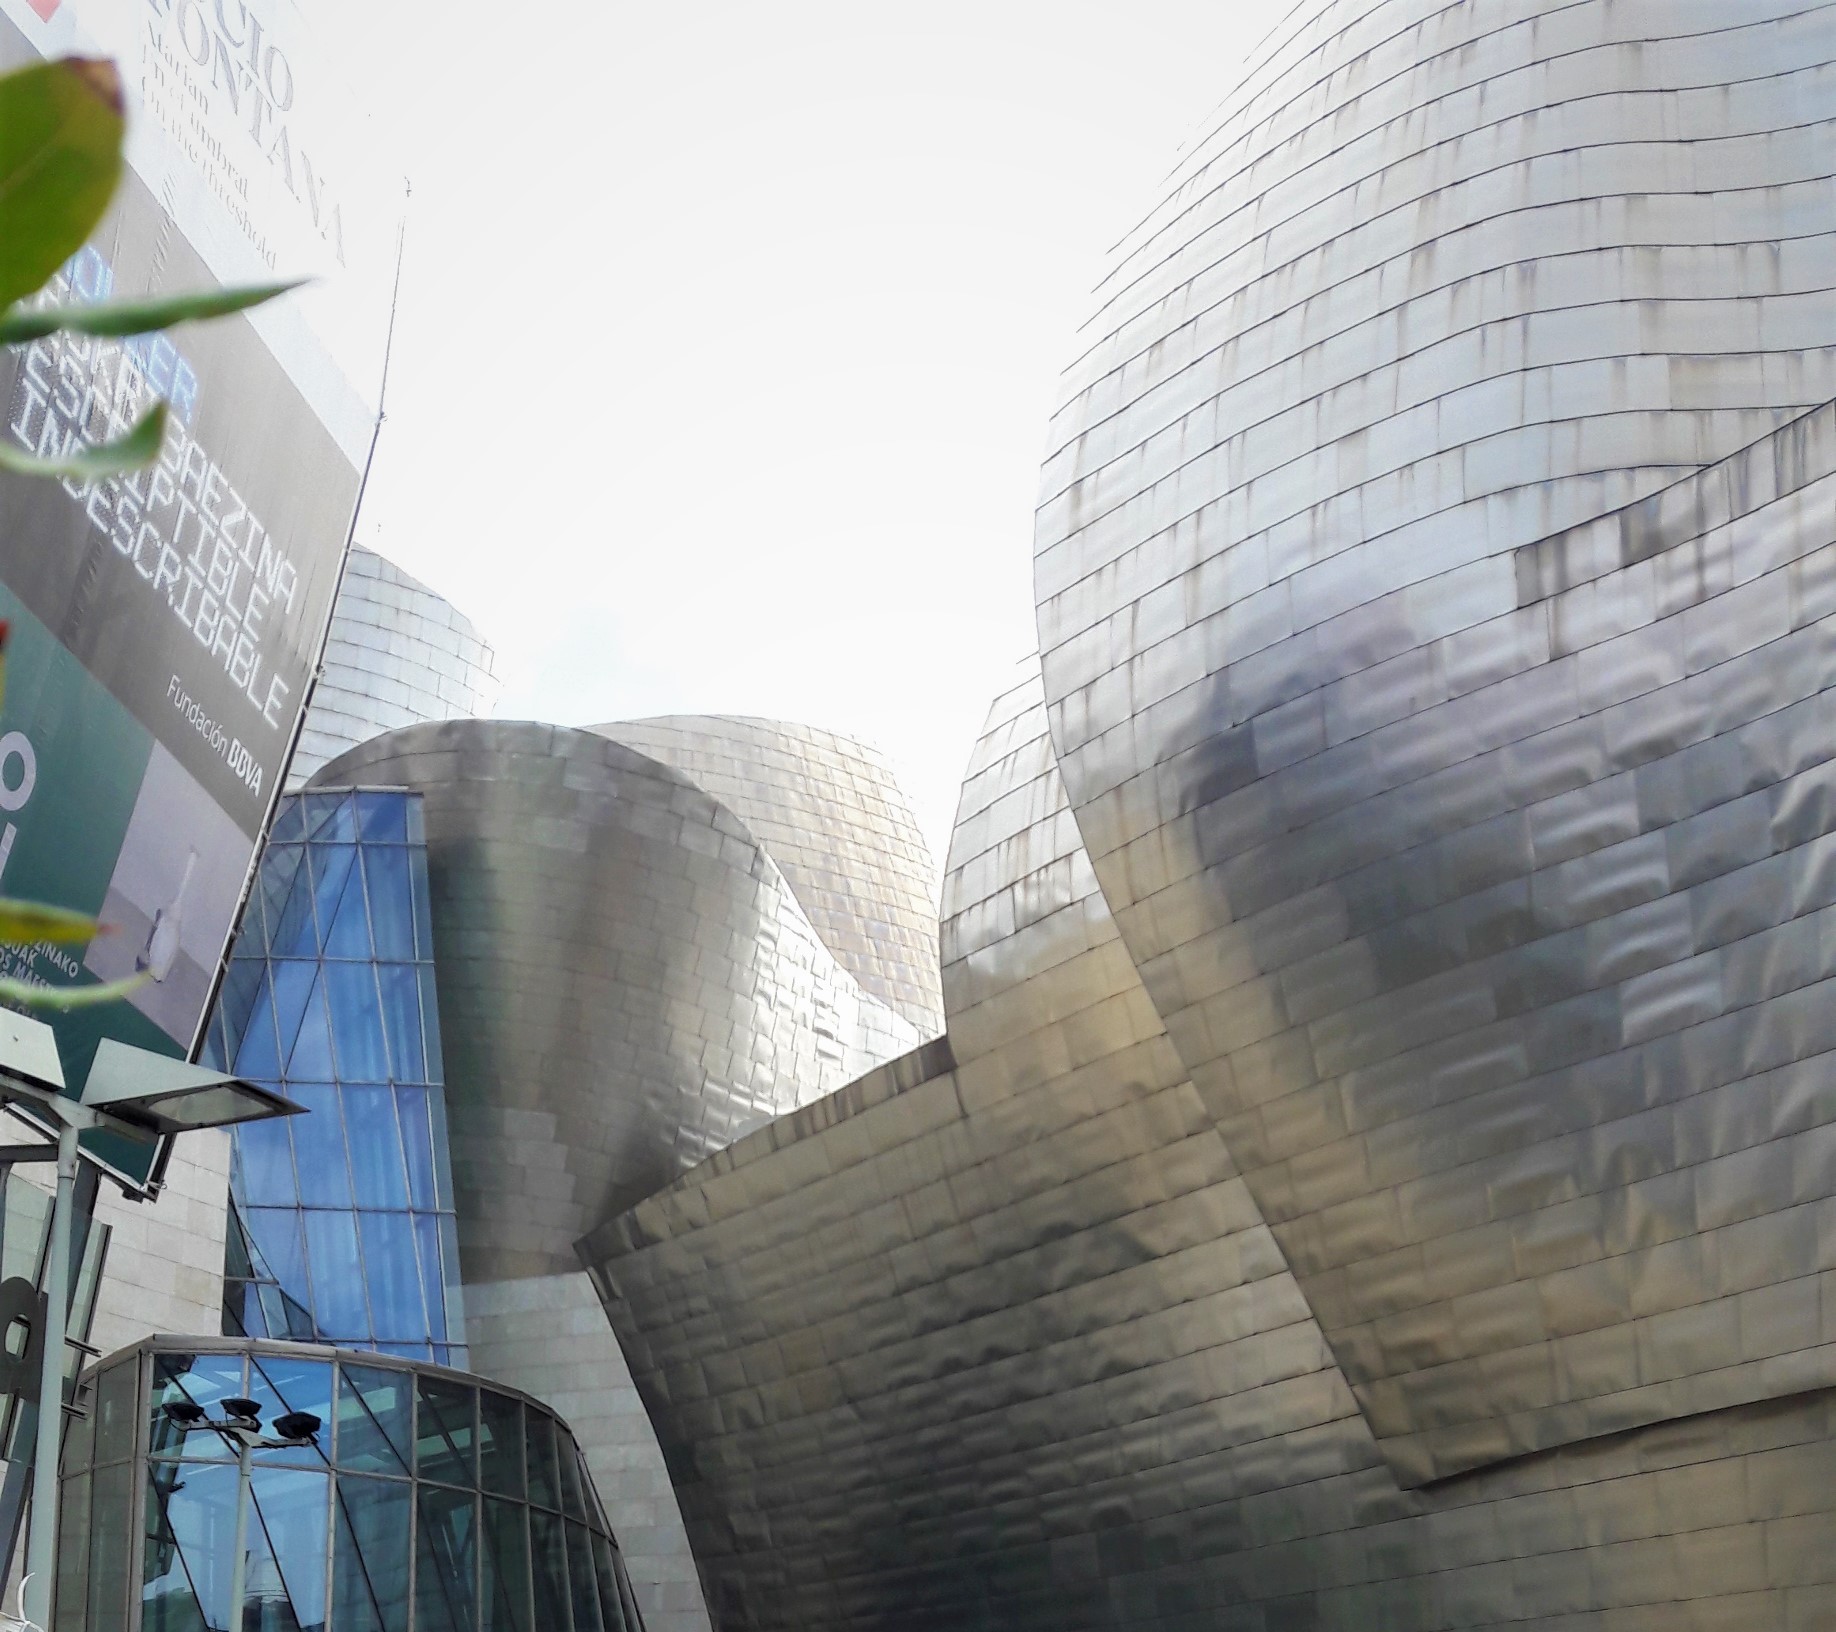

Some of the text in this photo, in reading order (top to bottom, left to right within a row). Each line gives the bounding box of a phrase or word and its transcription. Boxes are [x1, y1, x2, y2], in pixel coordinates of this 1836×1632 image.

[148, 0, 346, 269] ONTANA
[166, 674, 263, 798] Fundación BBVA
